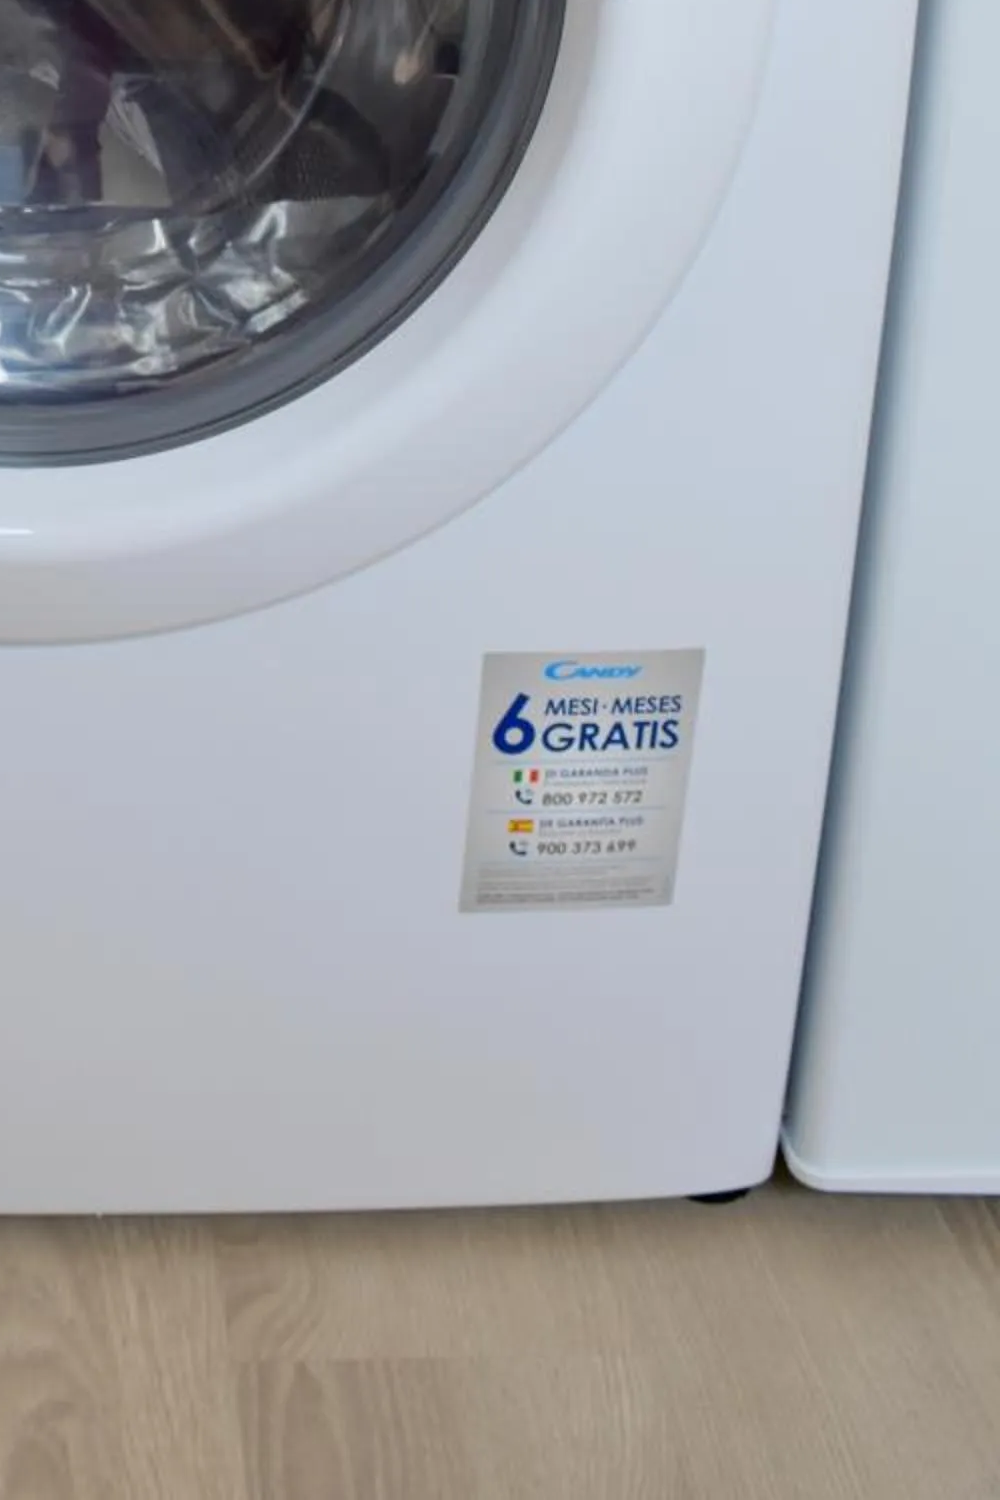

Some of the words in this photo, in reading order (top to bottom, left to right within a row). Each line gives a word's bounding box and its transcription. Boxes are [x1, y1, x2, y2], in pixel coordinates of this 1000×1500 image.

[543, 698, 598, 717] MESI
[609, 694, 682, 715] MESES
[492, 691, 536, 756] 6
[541, 718, 680, 753] GRATIS
[541, 791, 574, 807] 800
[577, 790, 608, 806] 972
[614, 789, 643, 805] 572
[536, 841, 567, 856] 900
[571, 840, 601, 855] 373
[606, 838, 637, 854] 699
